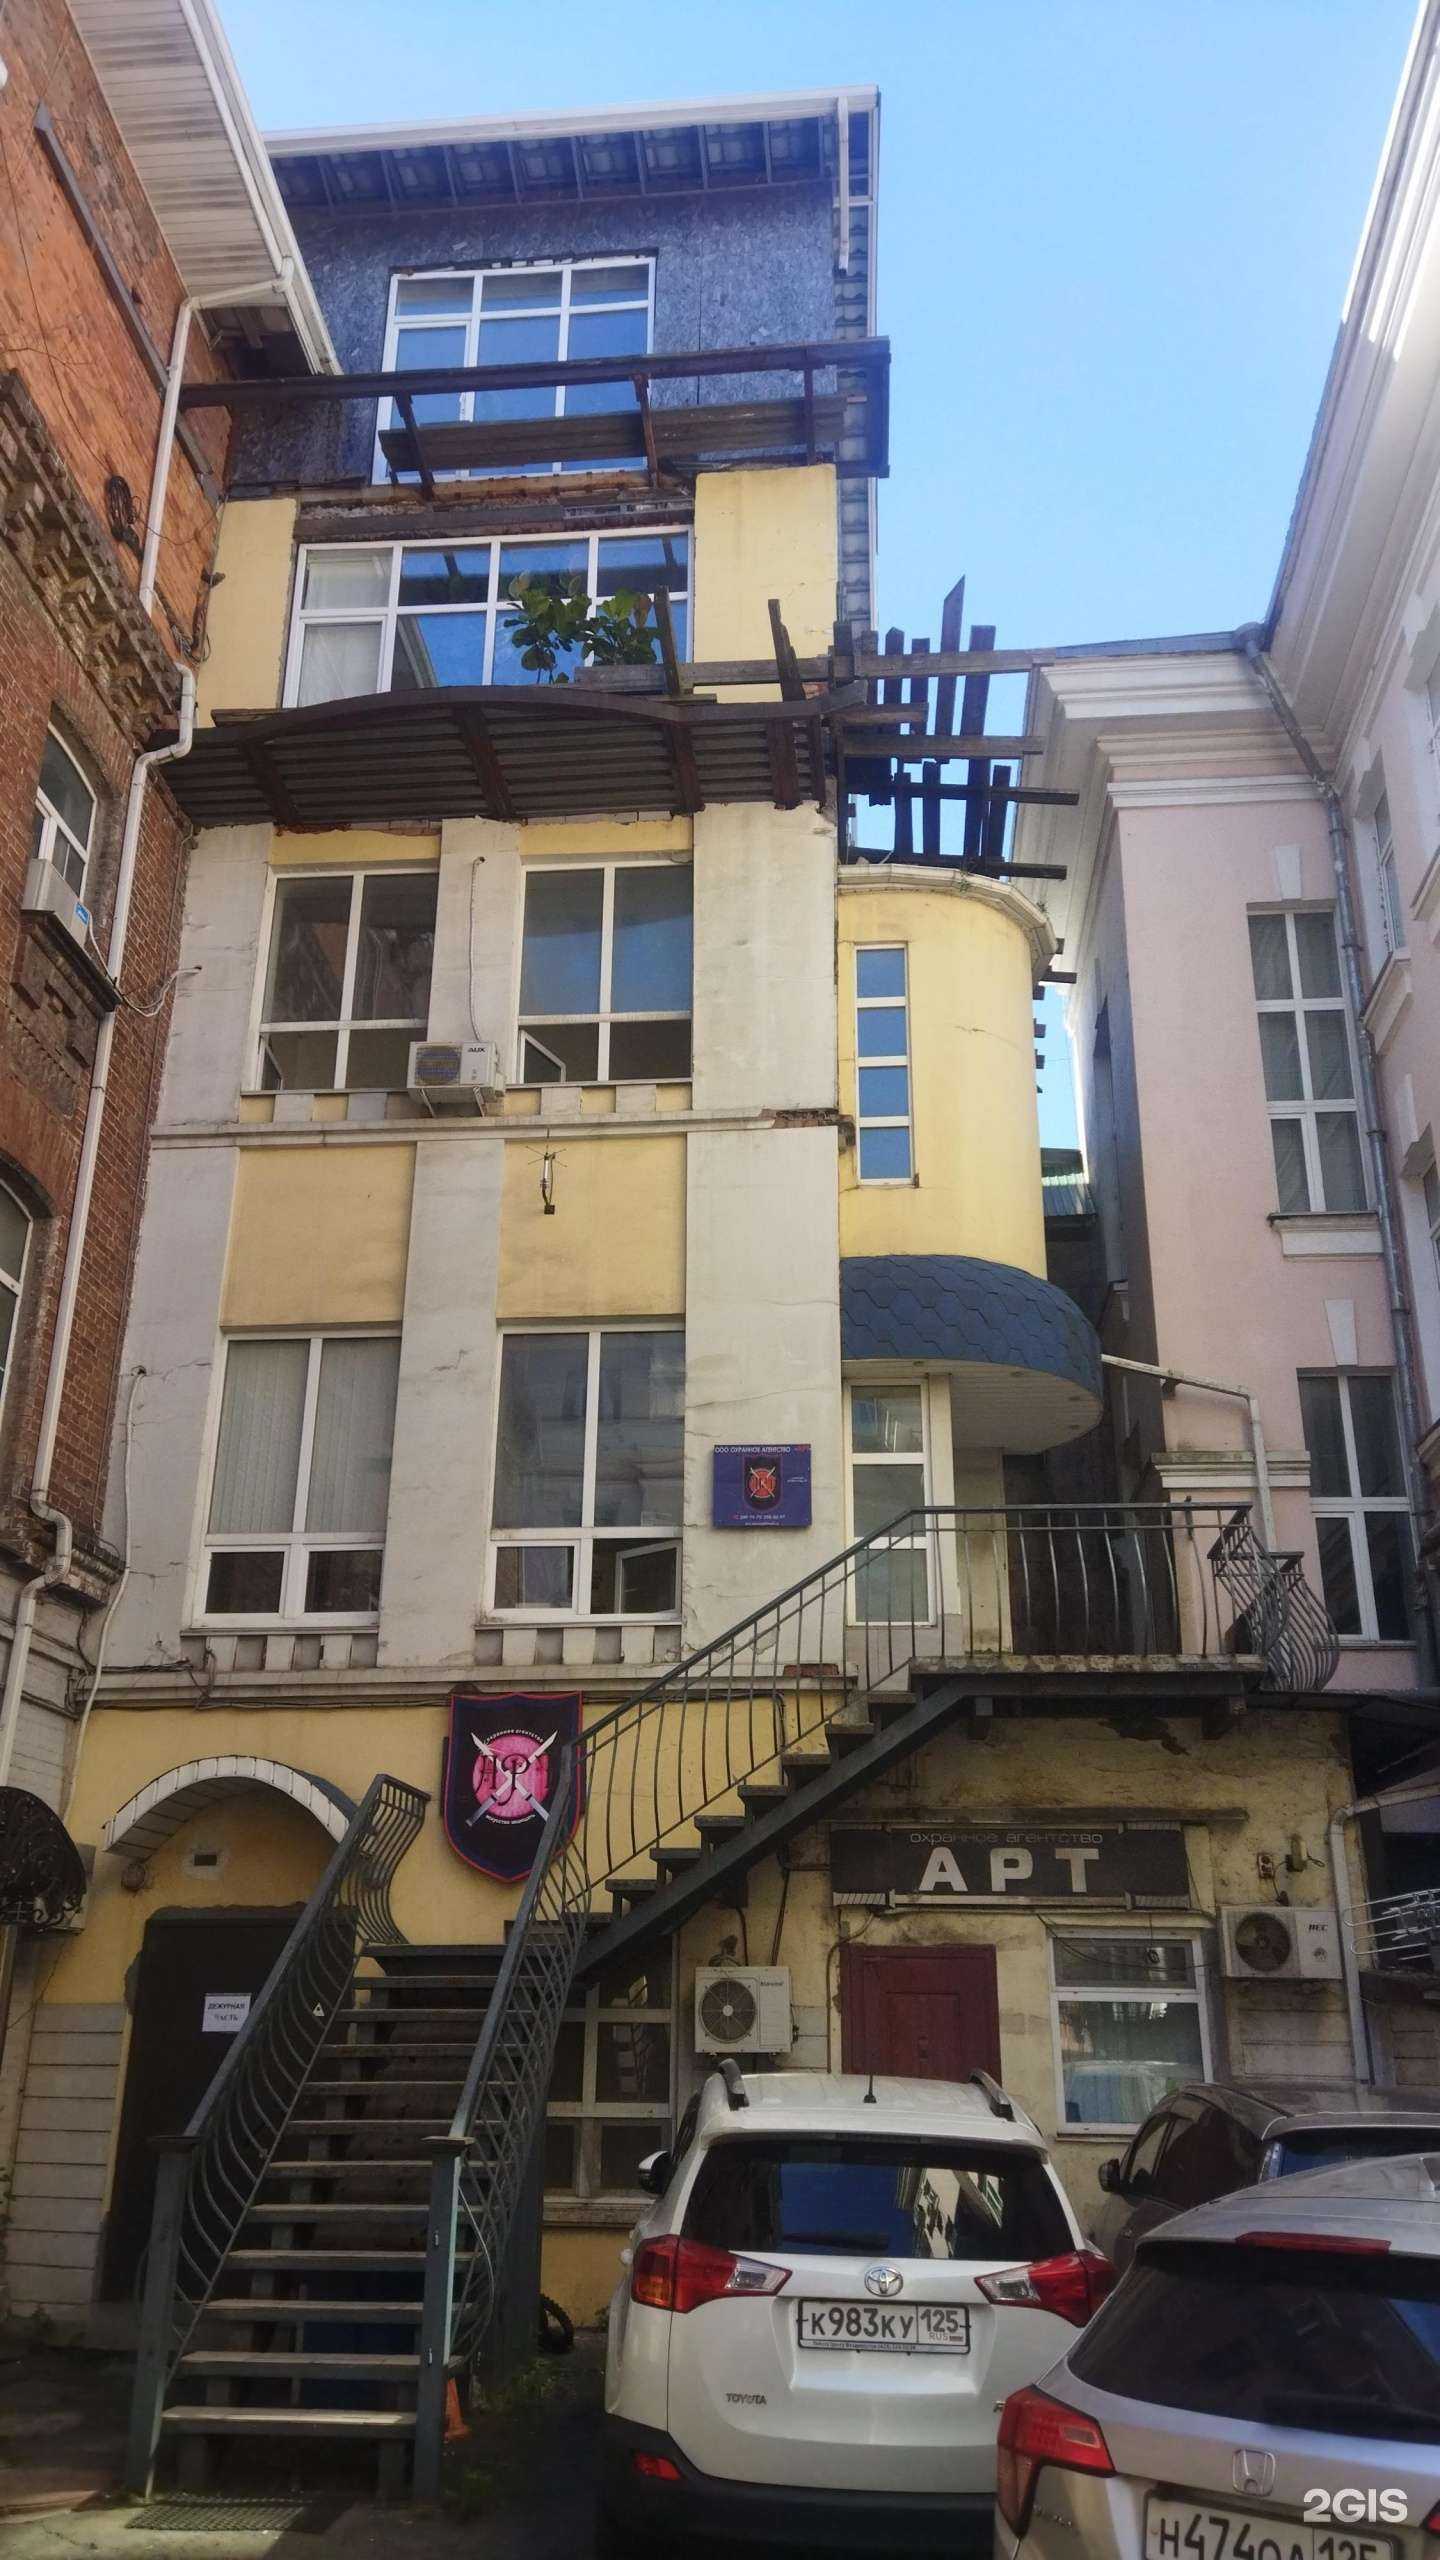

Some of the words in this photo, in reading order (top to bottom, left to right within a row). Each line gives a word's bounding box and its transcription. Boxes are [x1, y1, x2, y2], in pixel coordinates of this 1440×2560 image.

[910, 1832, 998, 1845] охранное
[1006, 1832, 1103, 1844] агентство
[918, 1846, 1101, 1893] АРТ
[811, 2307, 914, 2339] К983КУ
[920, 2309, 959, 2333] 125
[725, 2393, 767, 2405] TOYOTA
